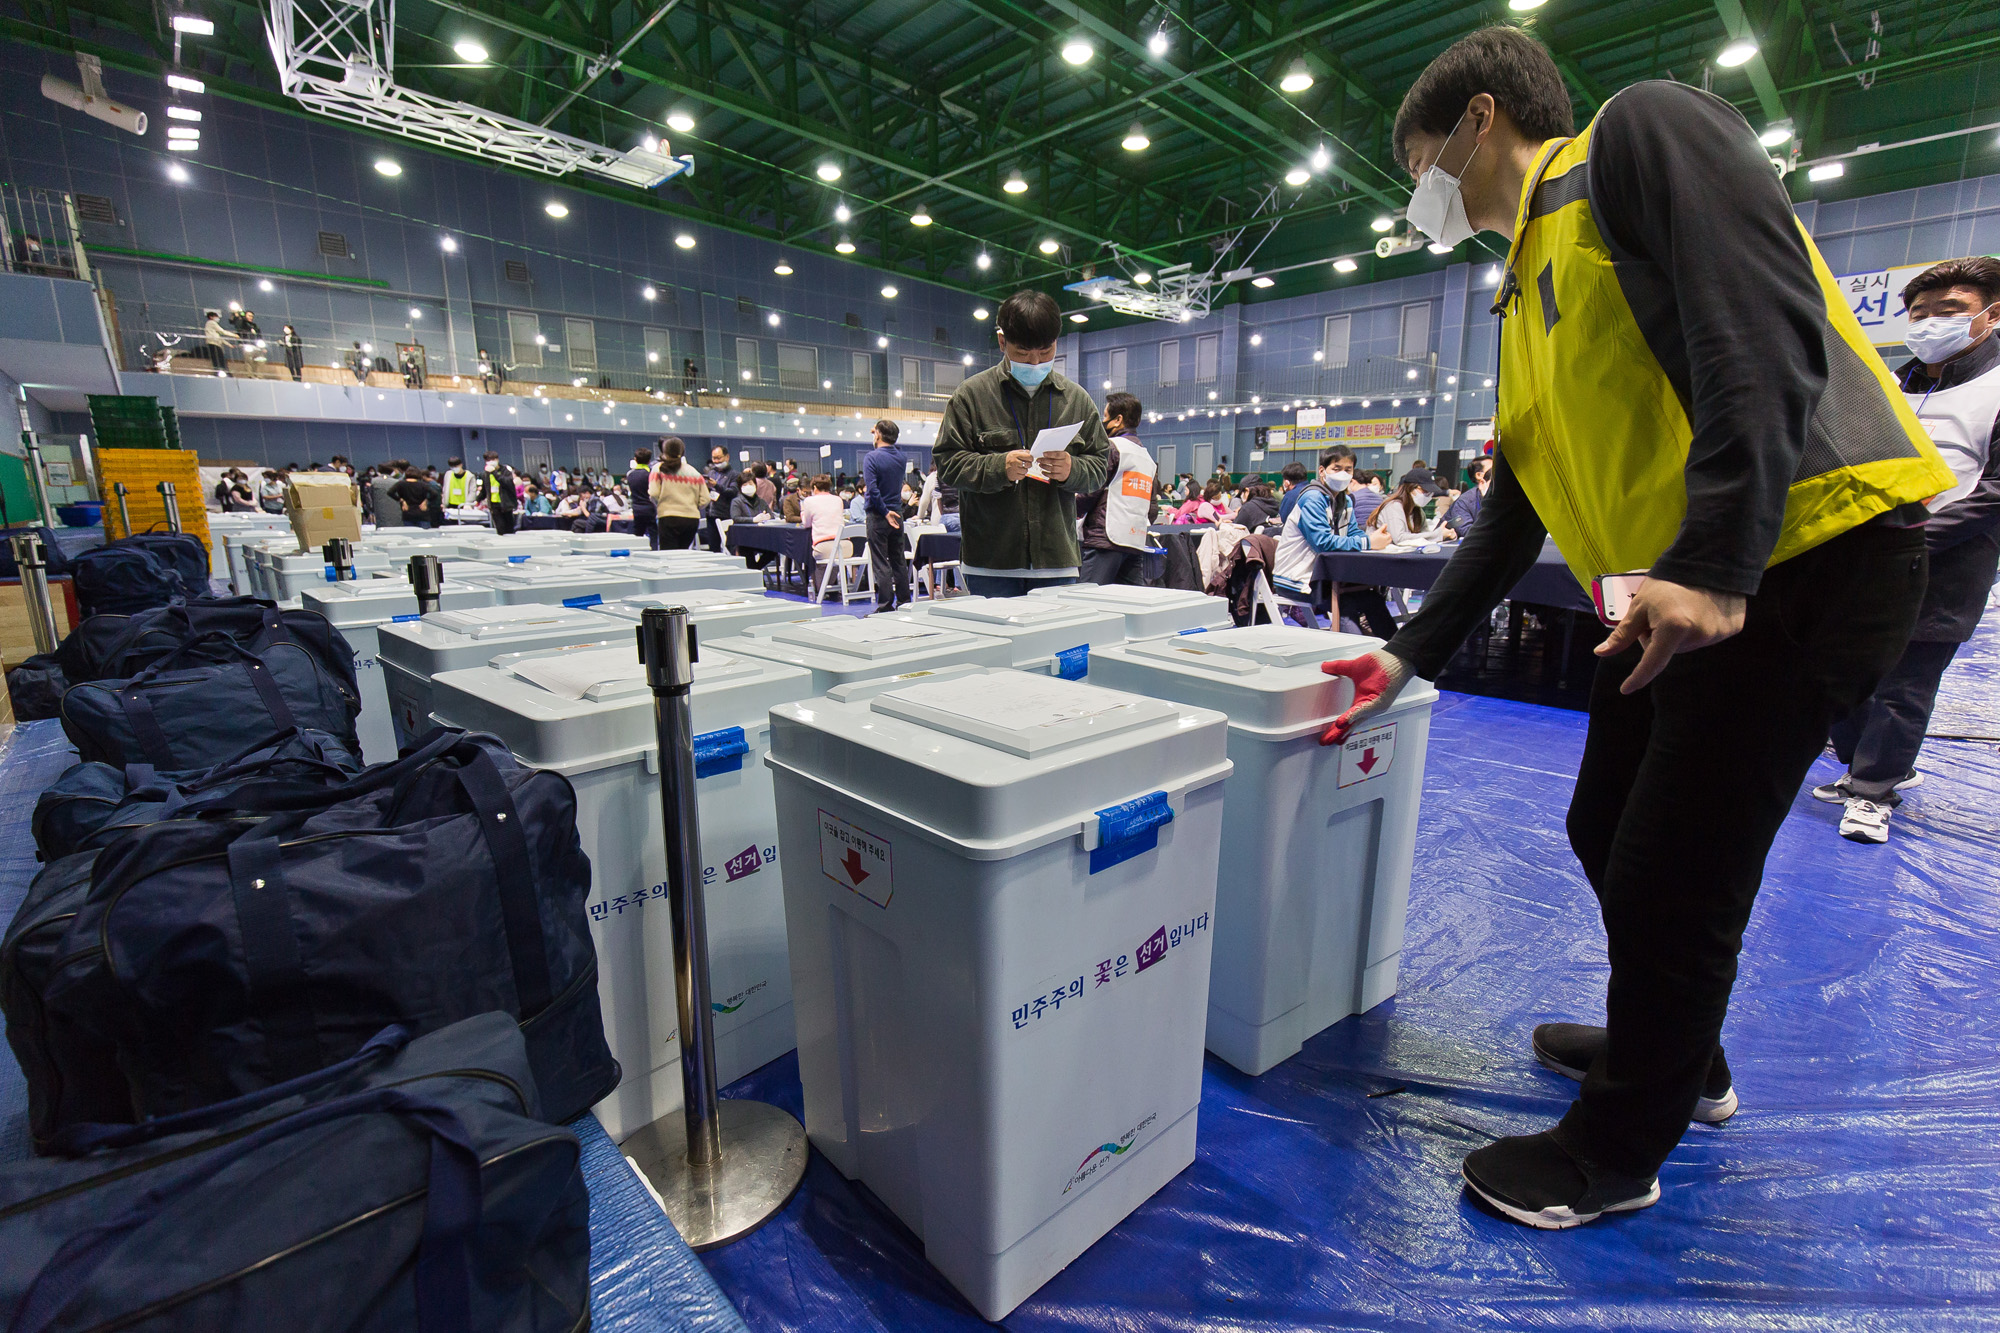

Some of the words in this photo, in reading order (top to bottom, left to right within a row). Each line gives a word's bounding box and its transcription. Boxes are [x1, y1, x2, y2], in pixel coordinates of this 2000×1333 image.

[1850, 273, 1889, 292] 실시
[868, 843, 886, 862] 주세요
[589, 881, 668, 922] 민주주의
[1011, 975, 1085, 1030] 민주주의
[1094, 954, 1129, 990] 꽃은
